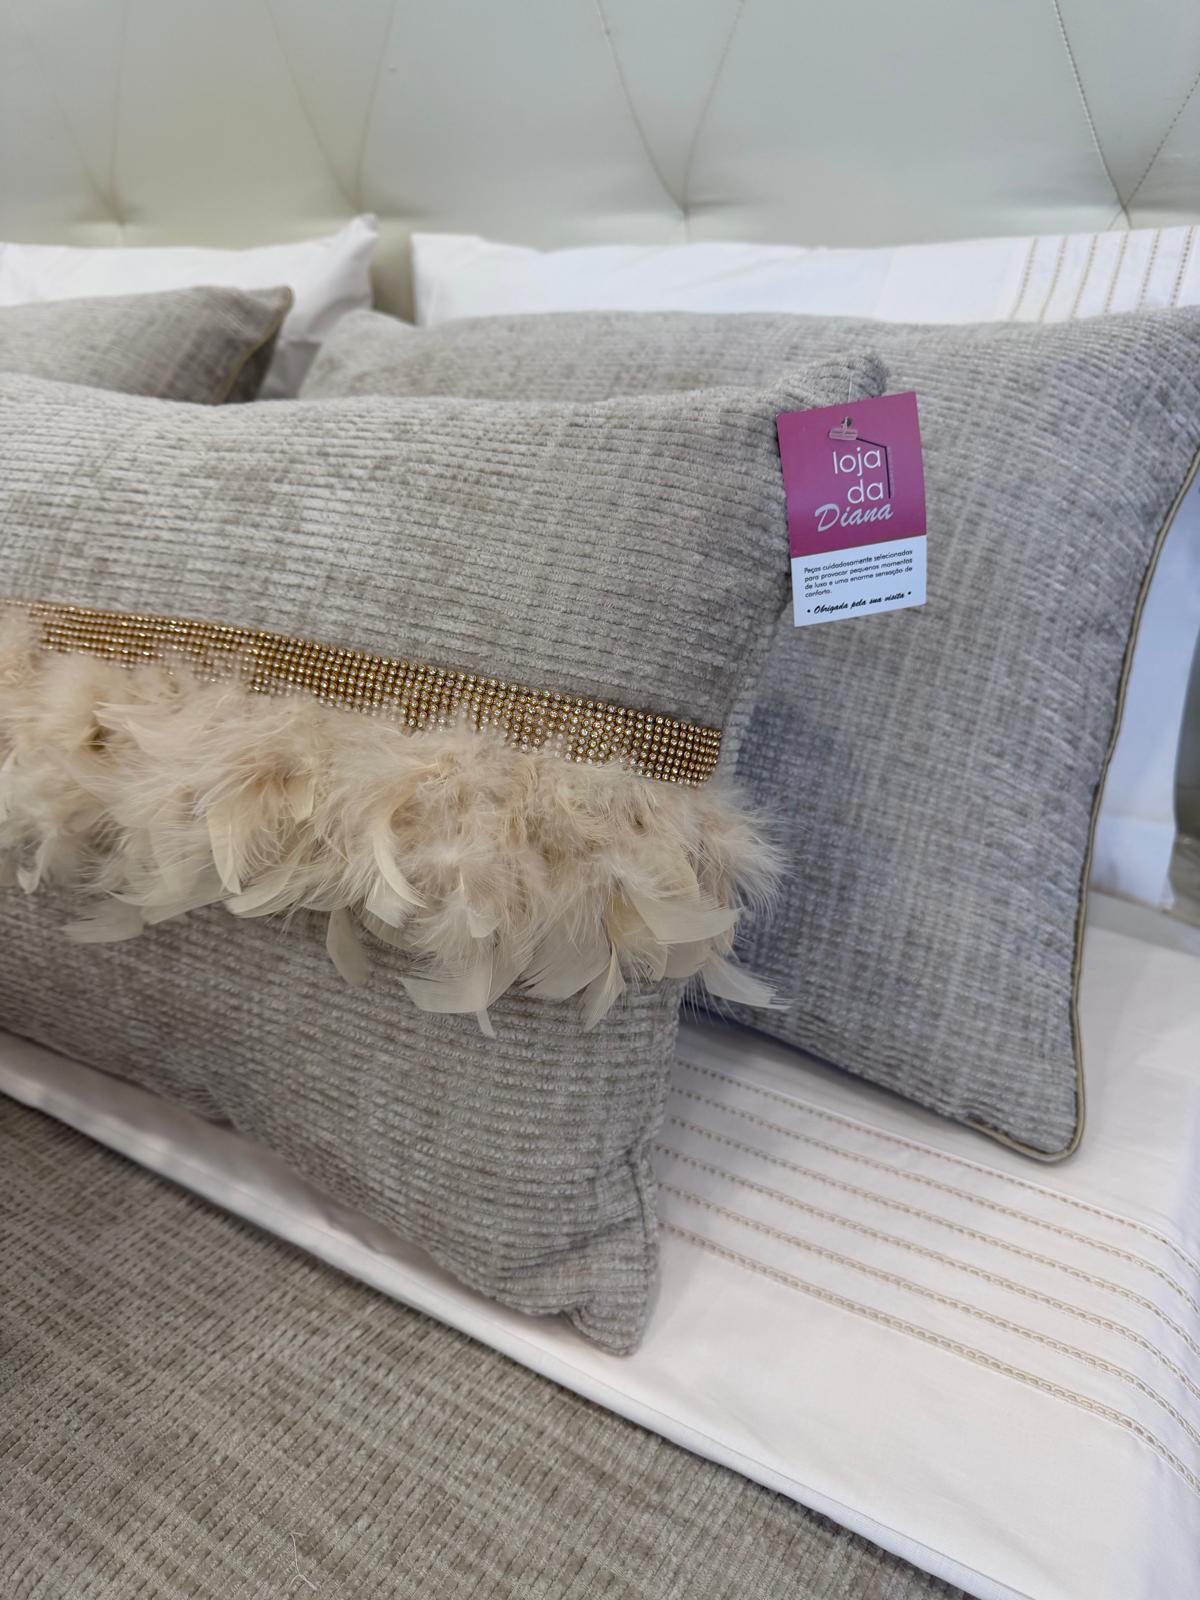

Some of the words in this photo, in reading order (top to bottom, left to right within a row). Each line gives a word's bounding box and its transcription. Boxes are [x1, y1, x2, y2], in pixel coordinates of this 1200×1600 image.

[833, 447, 881, 476] loja
[848, 479, 884, 504] da
[815, 503, 894, 532] Diana
[821, 570, 848, 580] provocar
[850, 565, 879, 574] pequenos
[881, 558, 912, 568] momentos
[822, 556, 872, 570] cuidadosamente
[874, 549, 912, 561] selecionadas
[850, 574, 874, 582] enorme
[875, 568, 903, 578] sensação
[805, 589, 832, 598] conforto.
[814, 602, 848, 614] Obrigada
[850, 599, 866, 609] pela
[884, 592, 904, 602] visita
